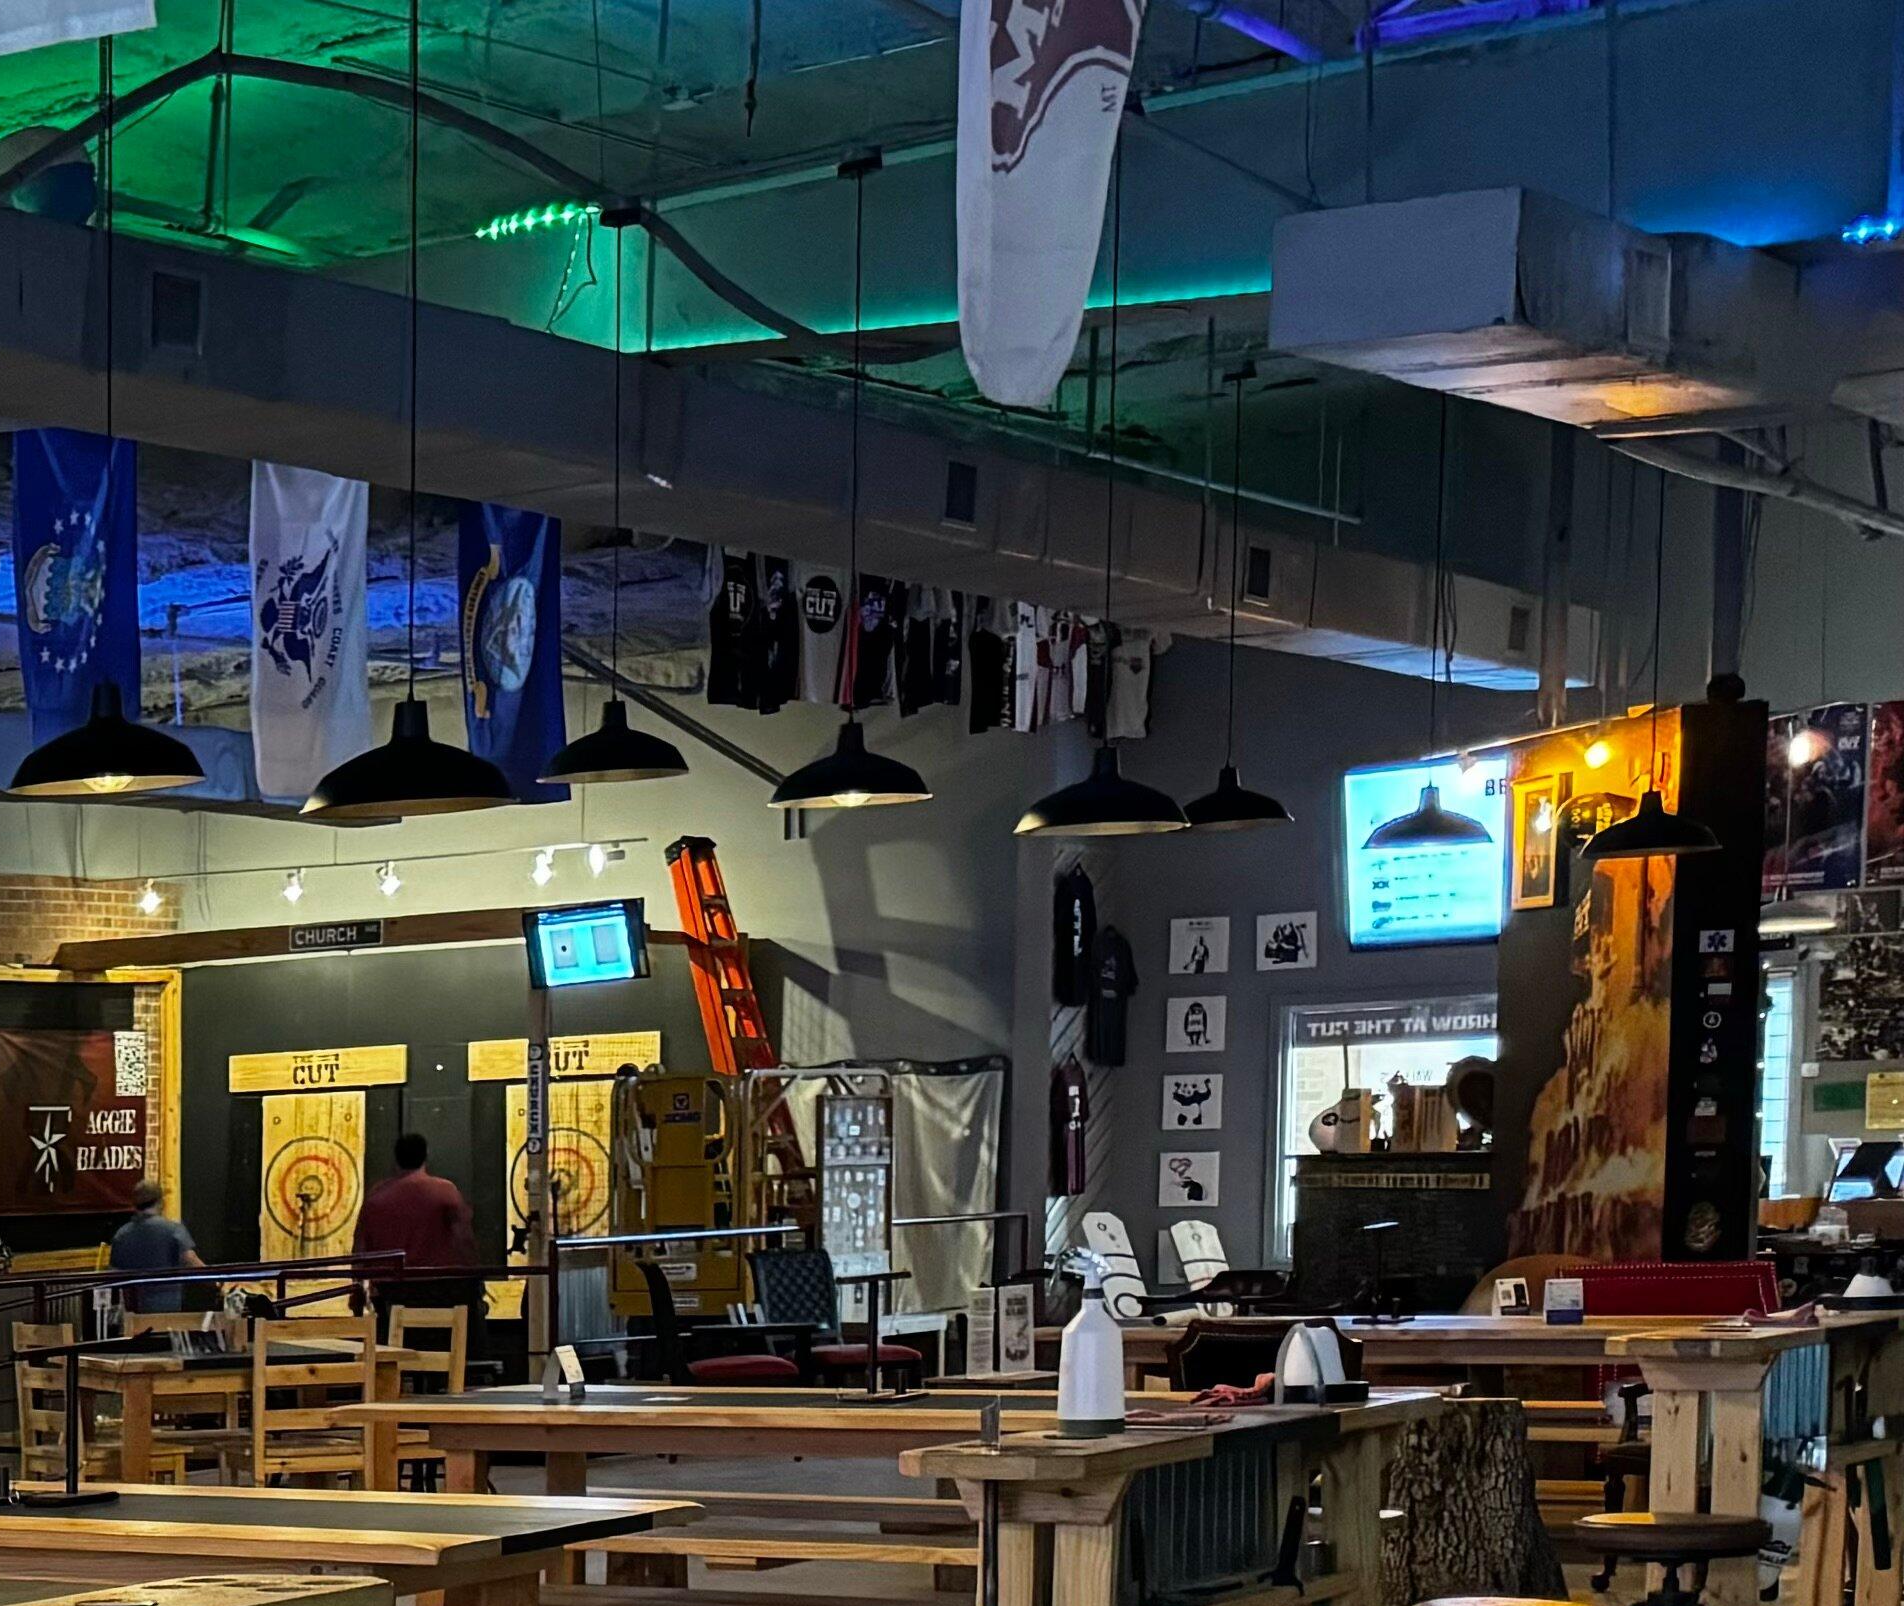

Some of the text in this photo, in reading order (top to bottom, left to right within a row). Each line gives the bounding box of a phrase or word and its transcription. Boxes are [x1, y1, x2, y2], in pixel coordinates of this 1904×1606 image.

[805, 596, 837, 617] CUT
[294, 926, 358, 946] CHURCH
[554, 1050, 590, 1072] UT
[292, 1063, 340, 1085] CUT
[85, 1109, 136, 1135] AGGIE
[76, 1145, 143, 1172] BLADES
